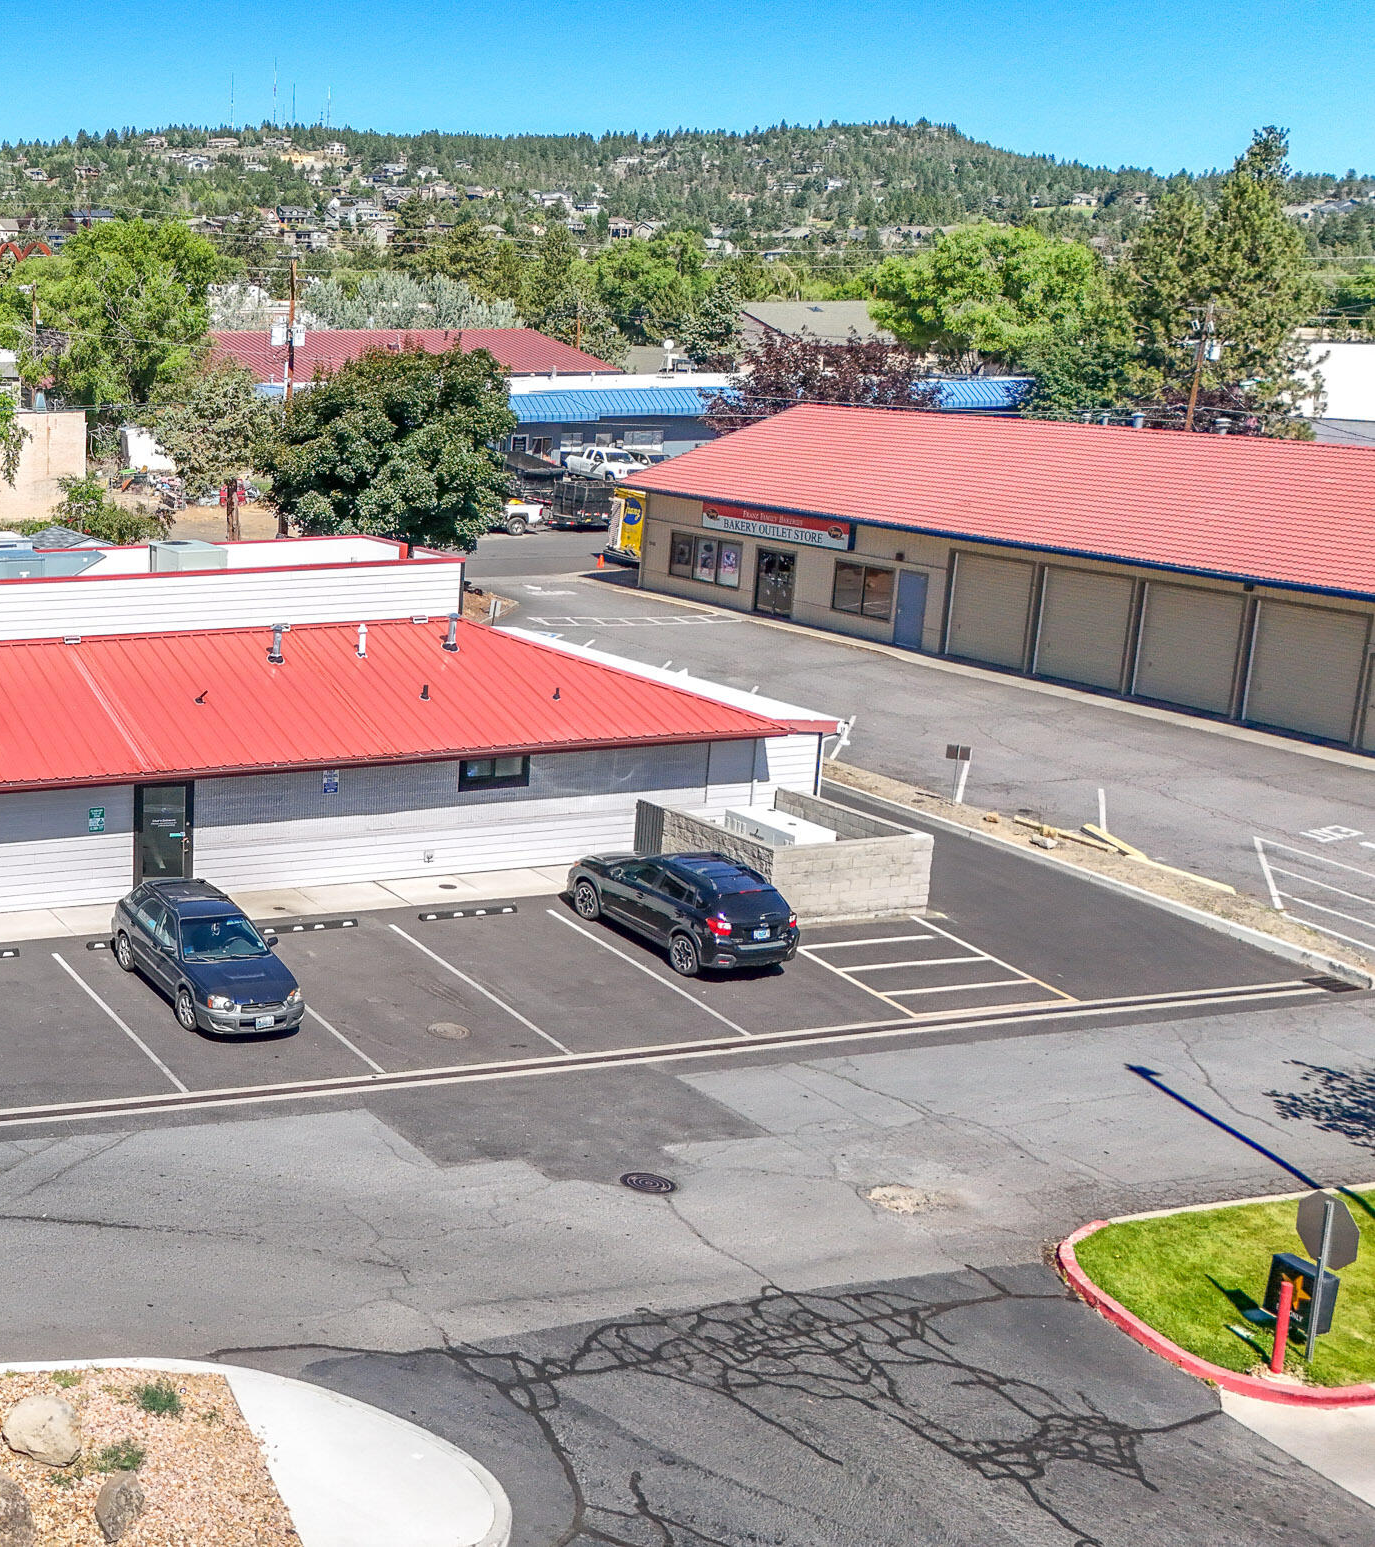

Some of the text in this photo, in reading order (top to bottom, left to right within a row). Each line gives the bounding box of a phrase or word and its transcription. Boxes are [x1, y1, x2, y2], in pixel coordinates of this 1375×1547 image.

[723, 518, 758, 534] BAKERY
[759, 524, 793, 539] OUTLET
[794, 530, 823, 544] STORE
